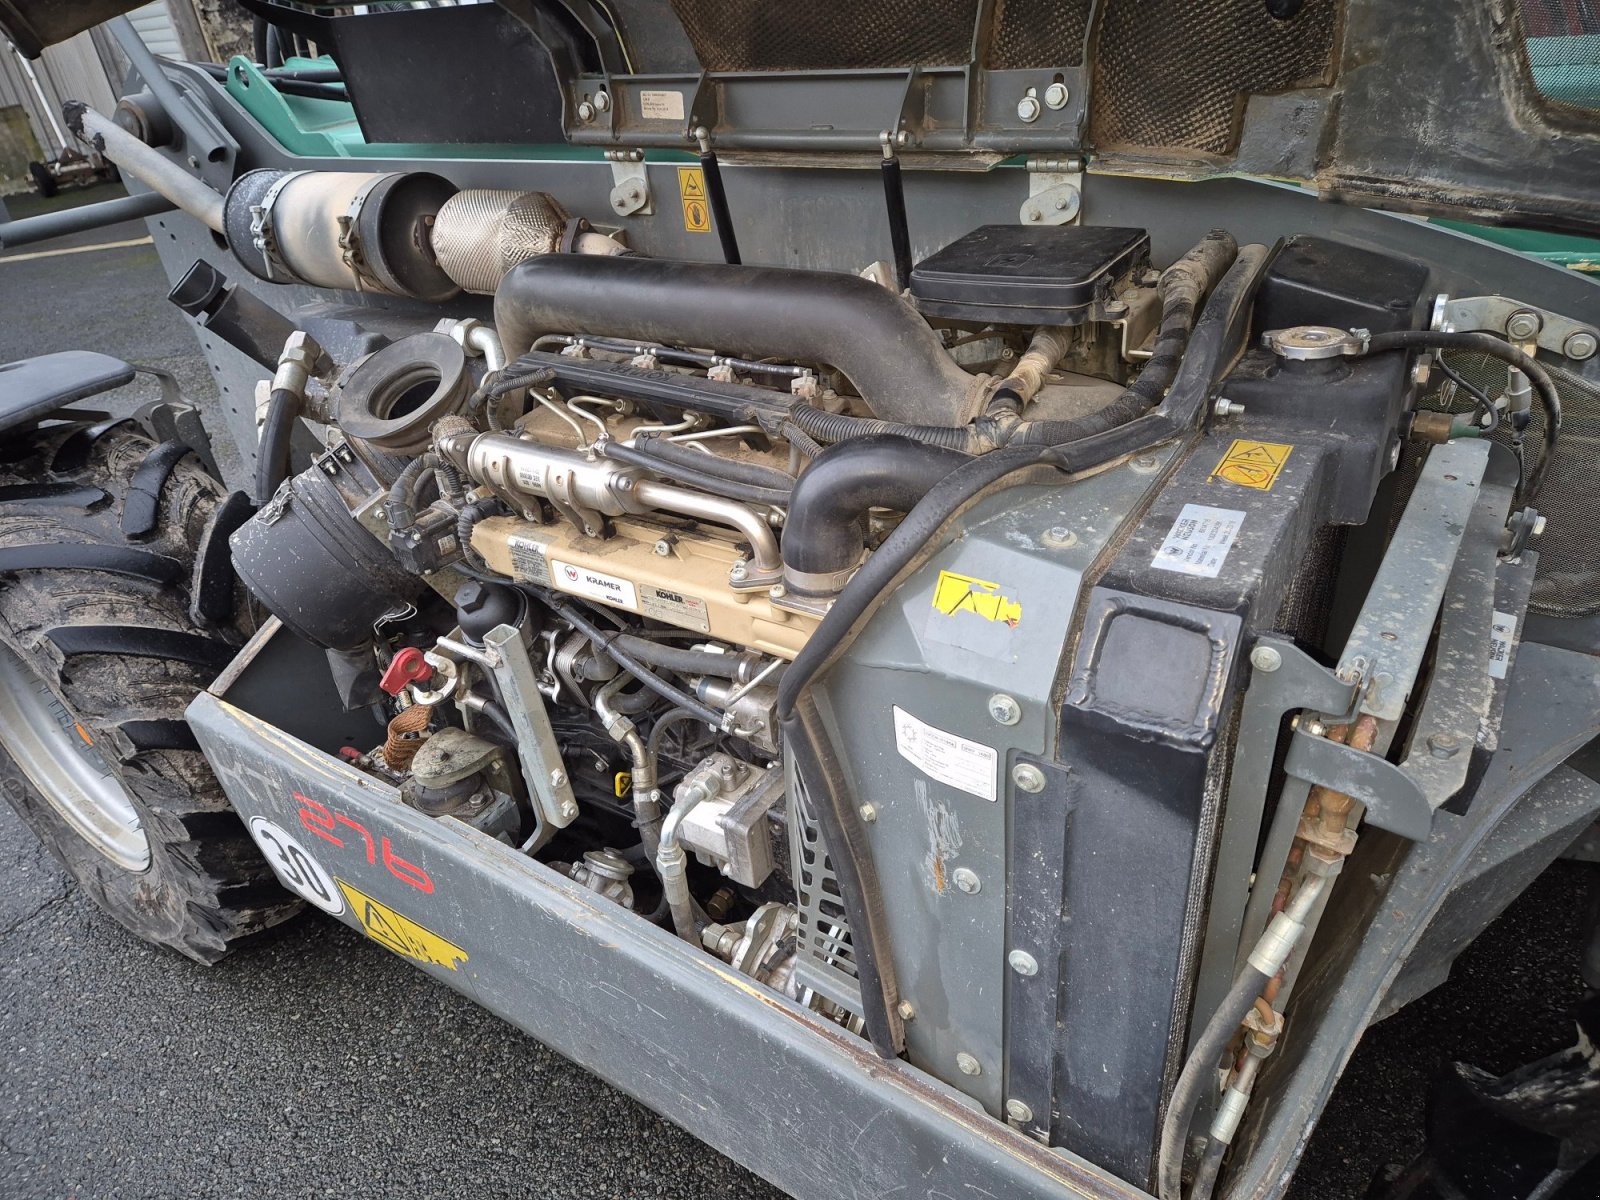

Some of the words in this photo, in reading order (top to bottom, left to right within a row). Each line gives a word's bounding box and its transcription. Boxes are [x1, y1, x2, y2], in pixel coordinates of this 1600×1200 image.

[514, 540, 540, 553] KOHLER
[586, 575, 622, 592] KRAMER
[605, 595, 623, 604] KOHLER
[656, 590, 683, 604] KOHLER
[292, 791, 435, 895] 276
[261, 829, 331, 903] 30
